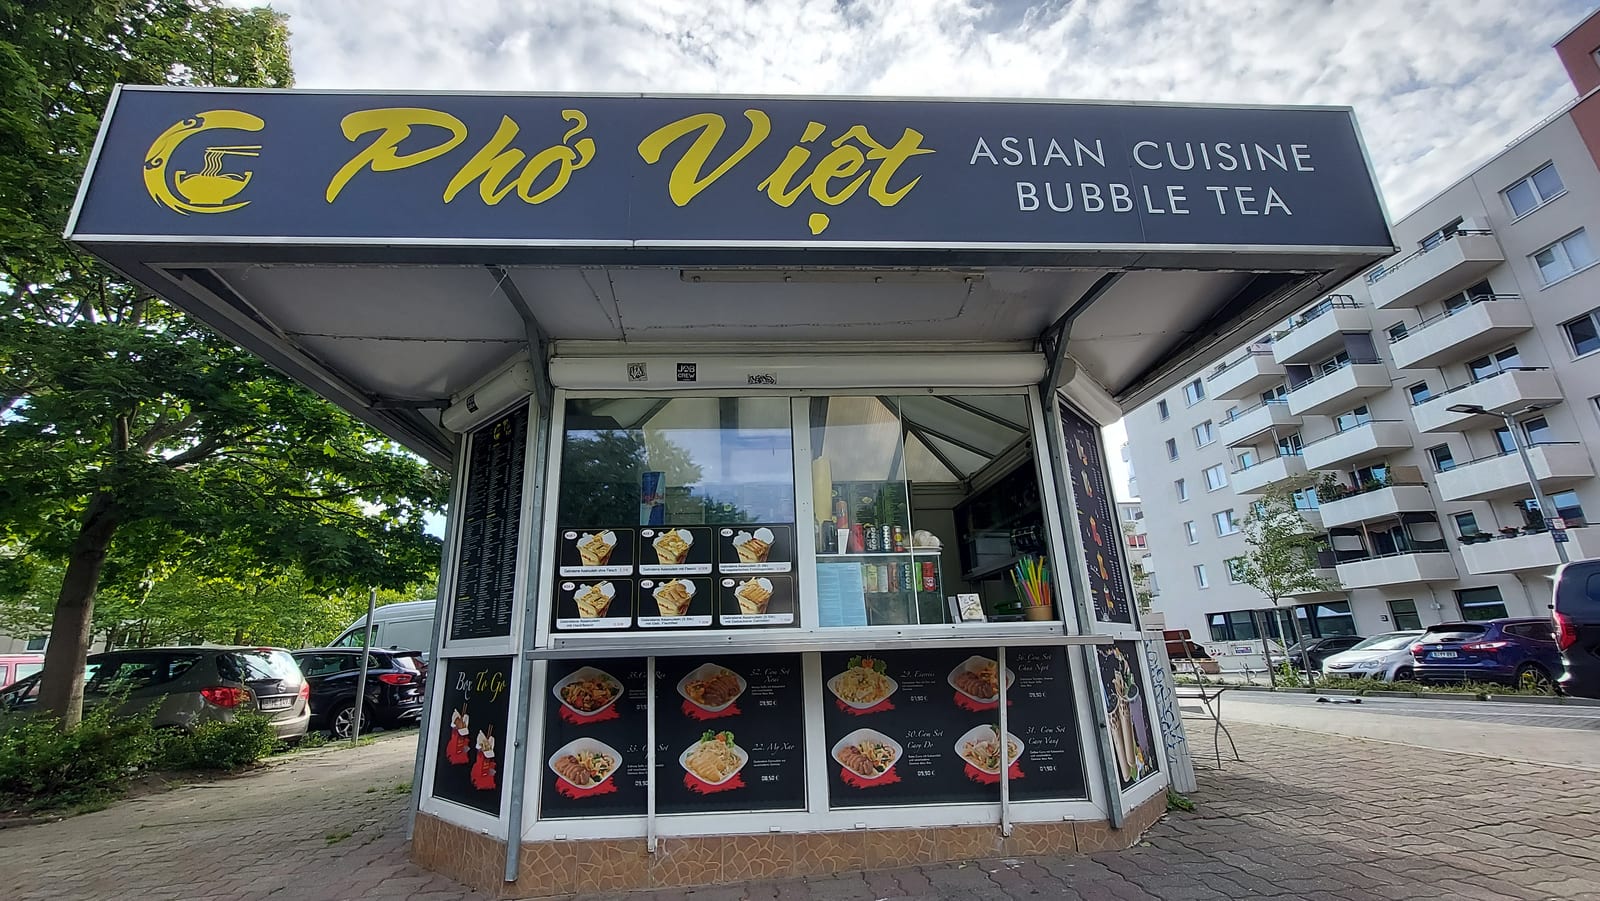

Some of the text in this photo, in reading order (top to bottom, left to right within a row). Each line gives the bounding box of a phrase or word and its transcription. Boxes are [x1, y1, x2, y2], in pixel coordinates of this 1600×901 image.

[969, 136, 1315, 171] ASIAN CUISINE
[326, 108, 936, 235] Phở Việt
[1016, 181, 1293, 216] BUBBLE TEA
[476, 668, 488, 692] To
[490, 671, 506, 703] Go
